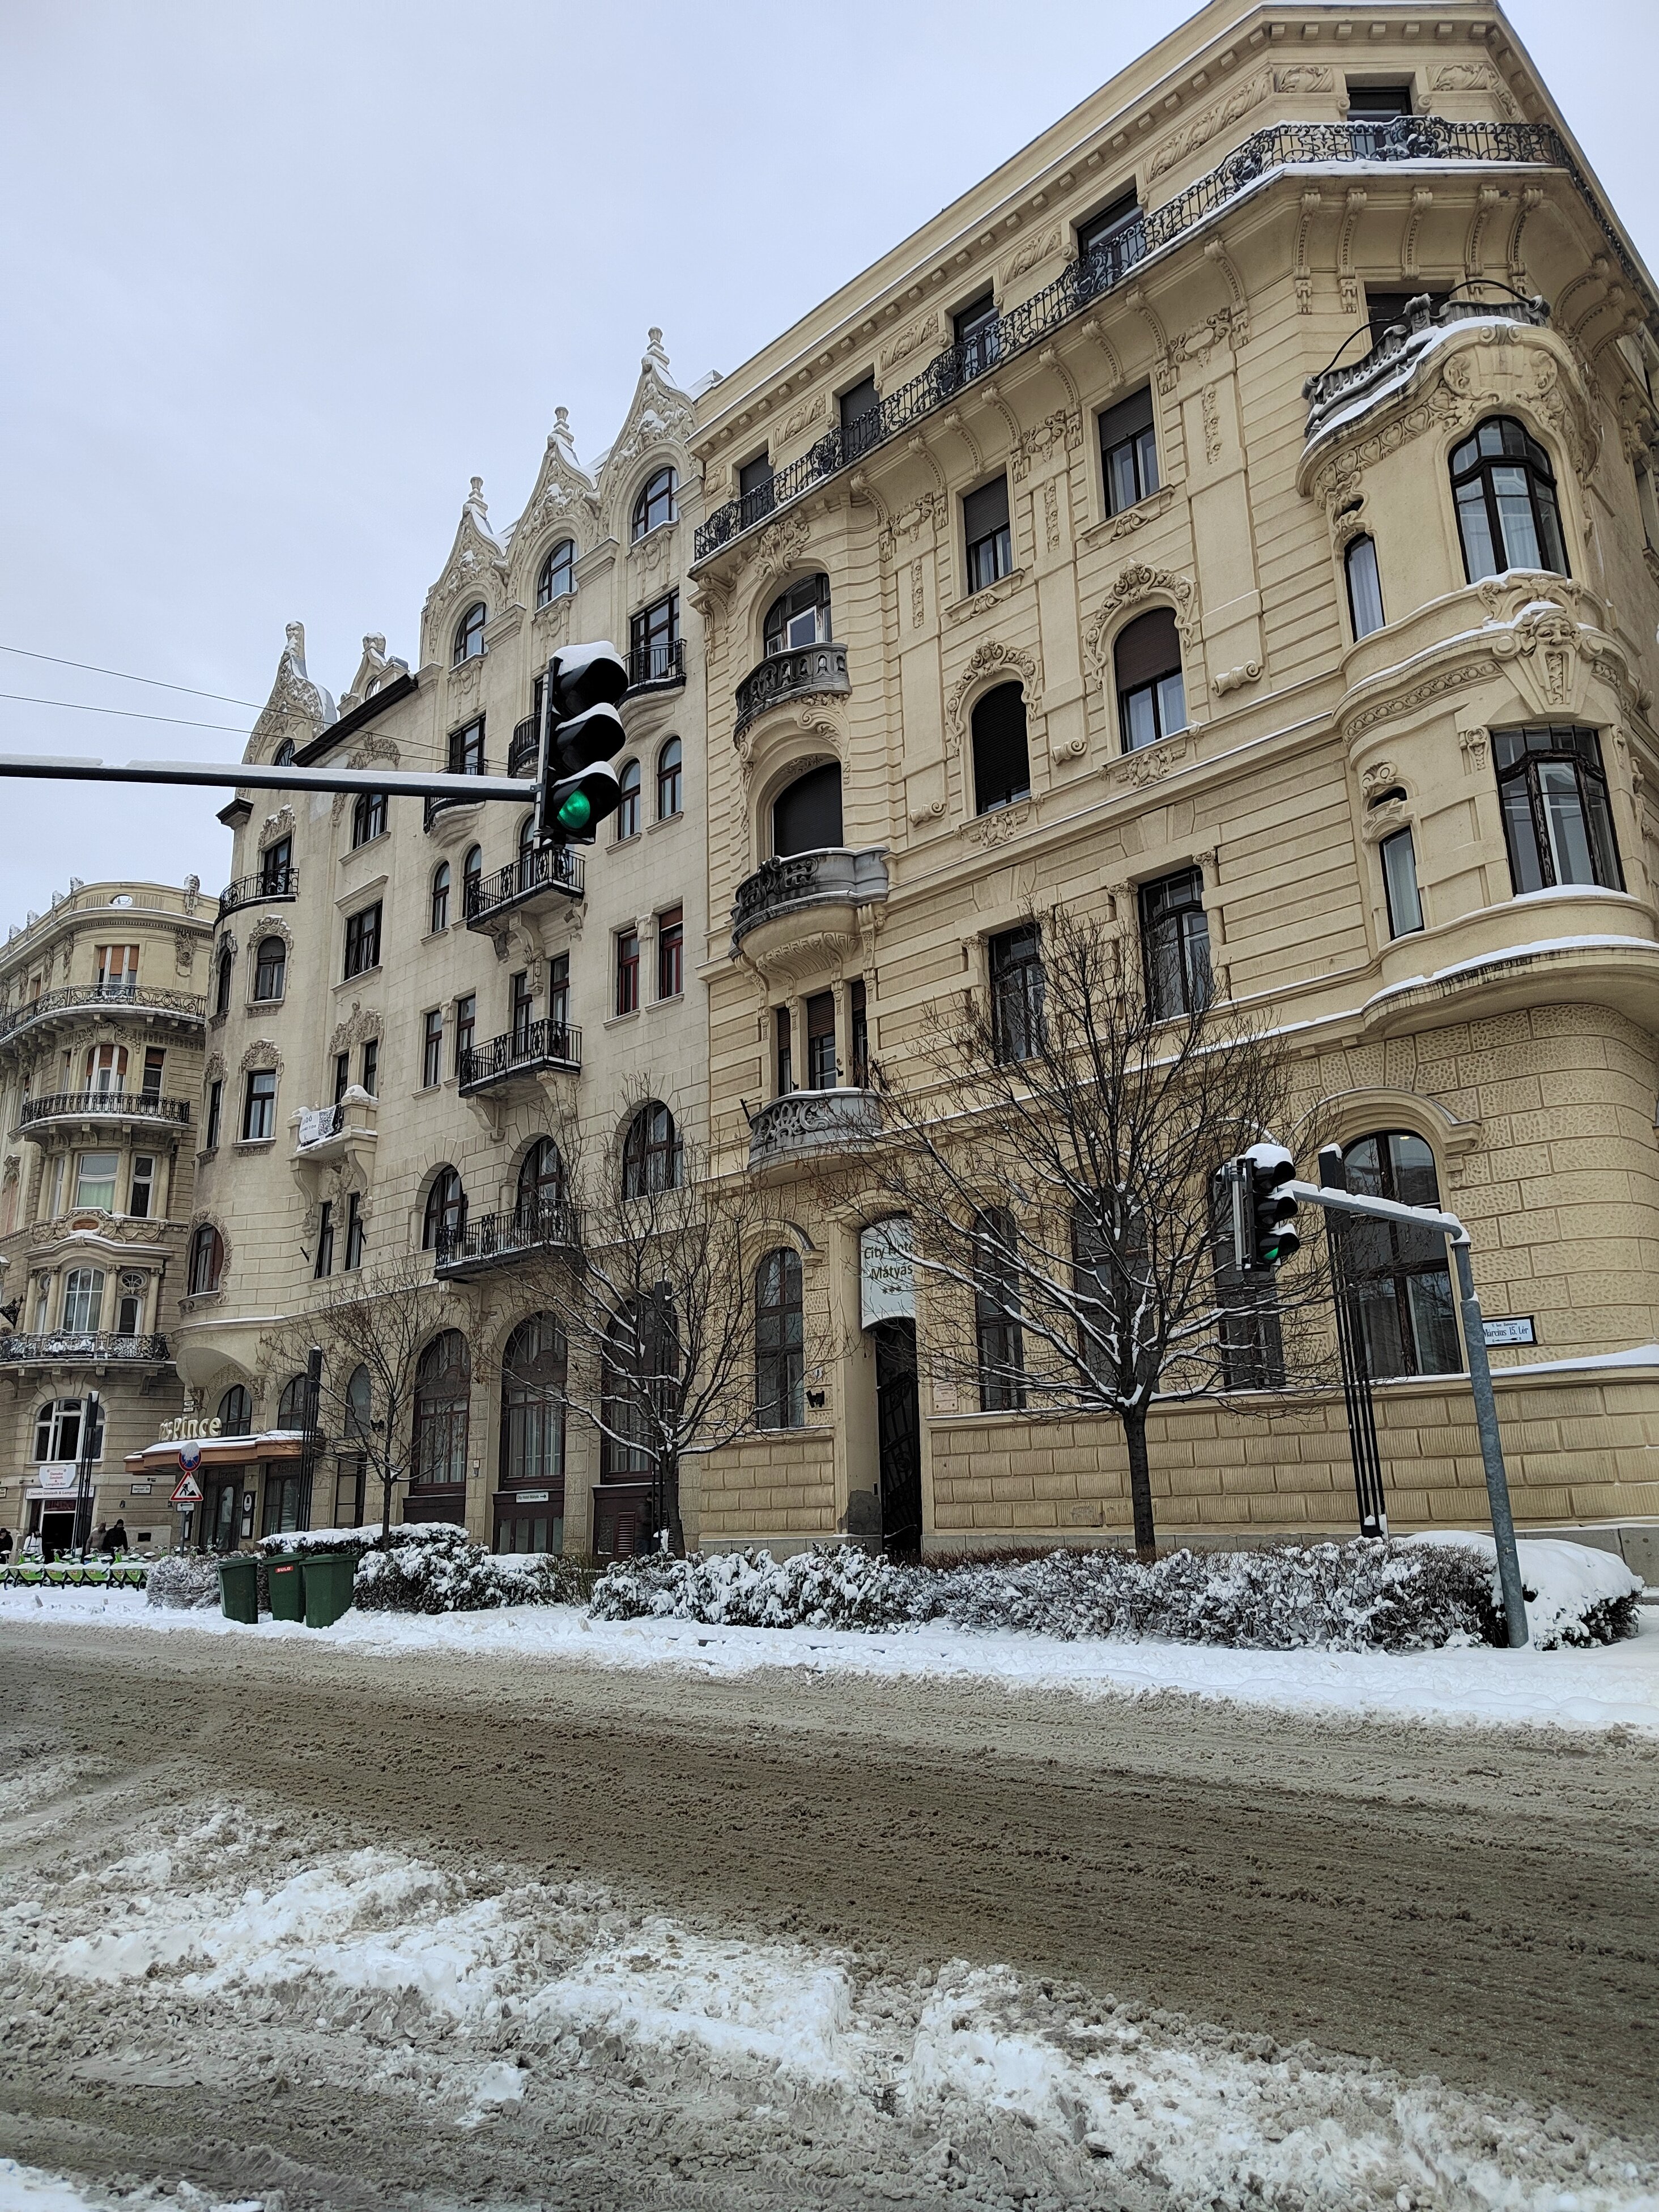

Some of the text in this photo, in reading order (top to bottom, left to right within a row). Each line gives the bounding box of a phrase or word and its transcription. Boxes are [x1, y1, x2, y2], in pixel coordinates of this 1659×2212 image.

[864, 1246, 885, 1260] City
[871, 1262, 913, 1279] Mátyás
[1509, 1326, 1517, 1335] 15.
[1518, 1326, 1529, 1335] tér
[172, 1416, 222, 1441] Pince
[278, 1463, 301, 1474] Restaur
